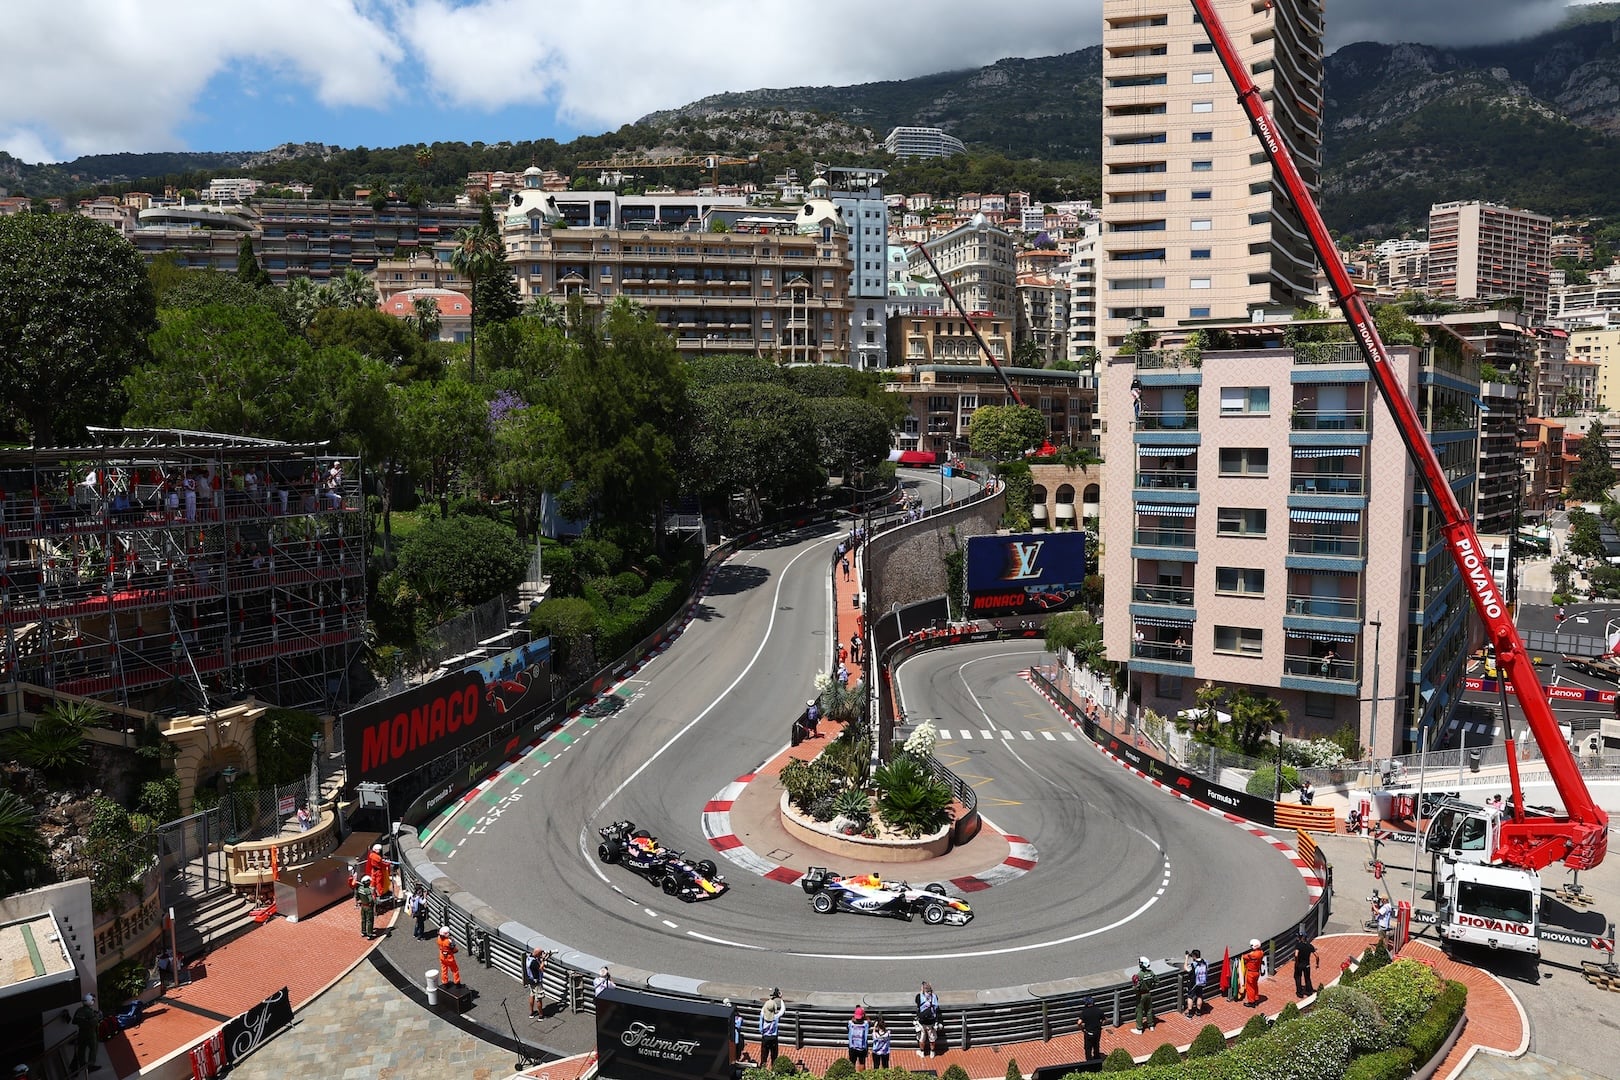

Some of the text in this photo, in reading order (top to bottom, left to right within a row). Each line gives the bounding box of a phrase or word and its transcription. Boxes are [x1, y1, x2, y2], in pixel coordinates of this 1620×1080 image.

[1255, 115, 1278, 153] PIOVANO
[1357, 322, 1381, 363] PIOVANO
[1456, 539, 1501, 619] PIOVANO
[973, 593, 1025, 609] MONACO
[1550, 688, 1582, 698] Lenovo
[361, 684, 479, 773] MONACO
[426, 787, 448, 810] Formula
[1207, 789, 1232, 805] Formula
[473, 793, 524, 835] TAXIS
[859, 900, 881, 909] VISA
[1459, 915, 1530, 936] PIOVANO
[1541, 931, 1588, 946] PIOVANO
[620, 1021, 701, 1056] Fairmont
[638, 1047, 683, 1061] MONTE CARLO
